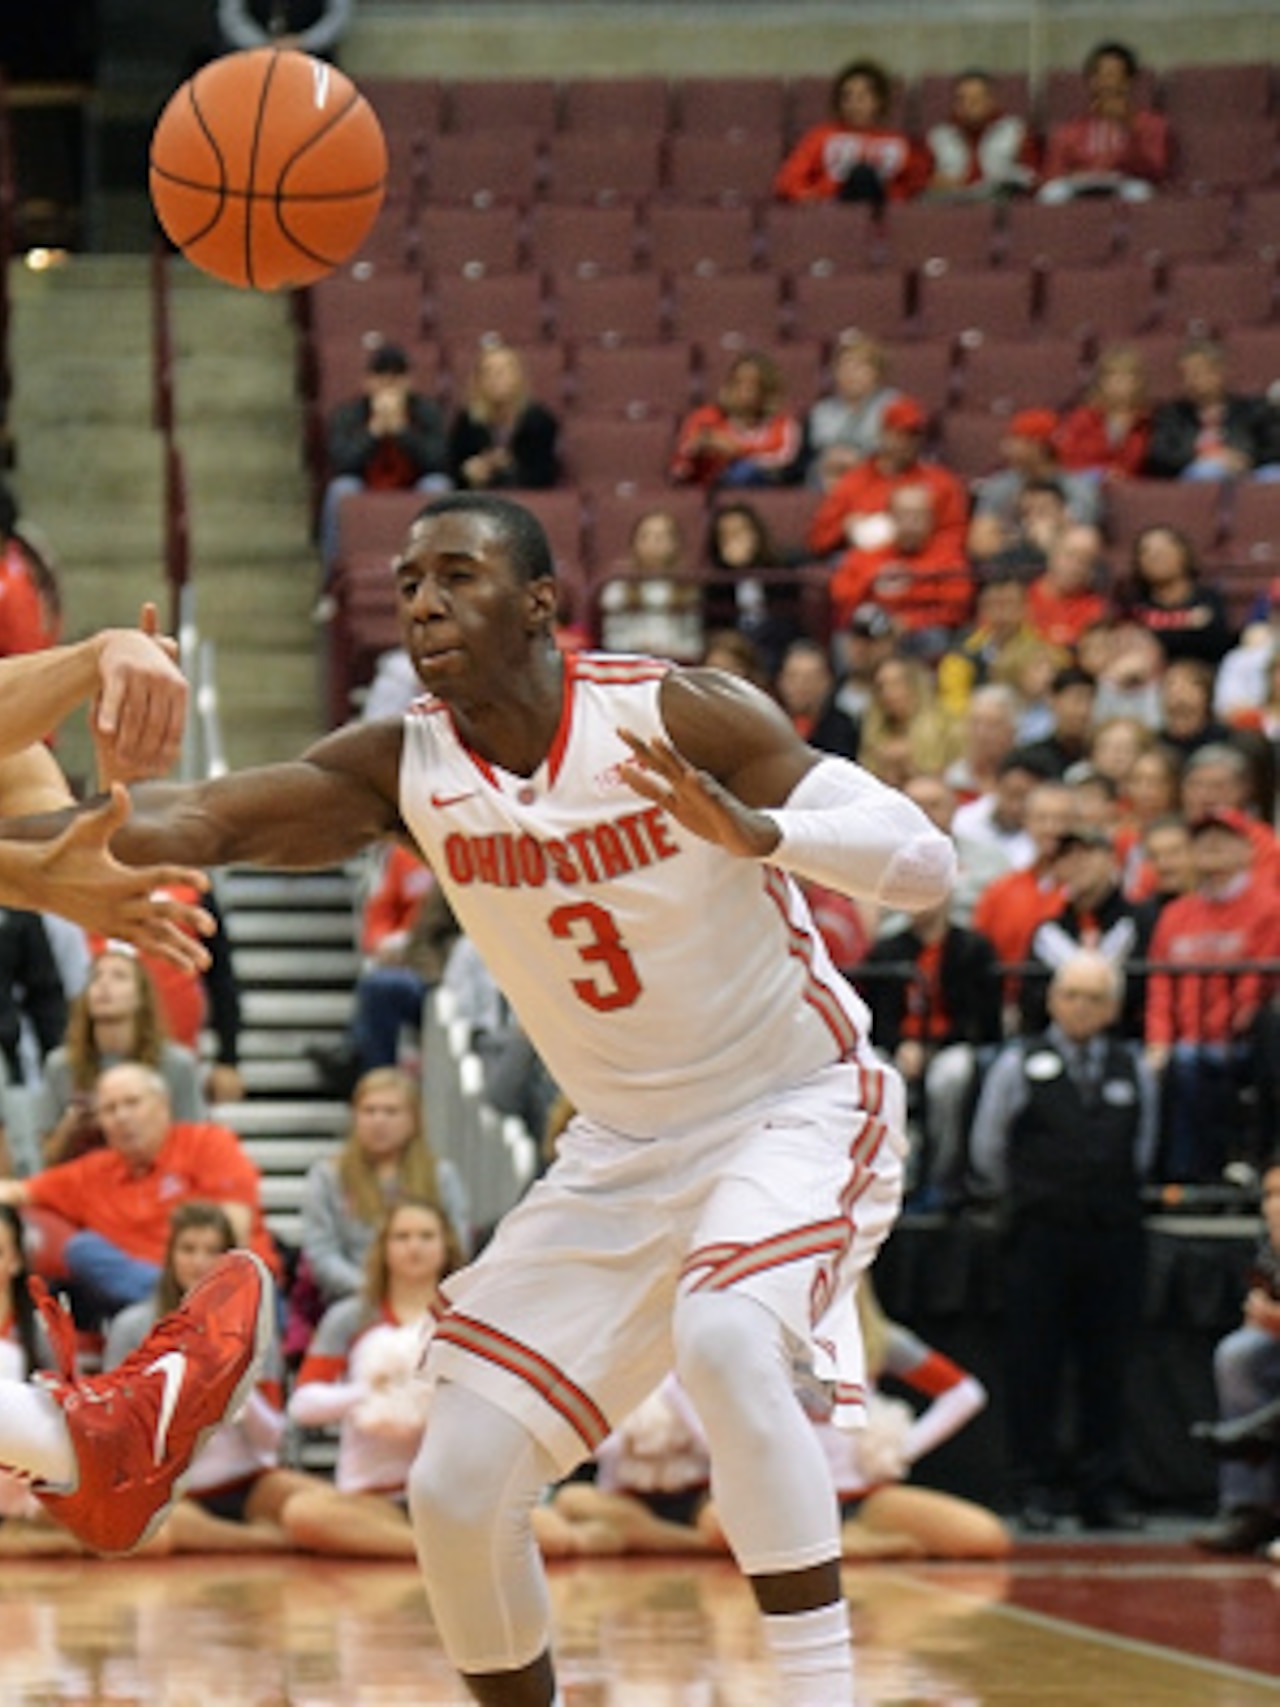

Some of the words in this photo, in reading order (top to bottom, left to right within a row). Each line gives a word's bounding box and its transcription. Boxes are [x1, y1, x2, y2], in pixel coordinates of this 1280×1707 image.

[444, 832, 547, 888] OHIO
[545, 805, 680, 885] STATE
[547, 901, 642, 1012] 3
